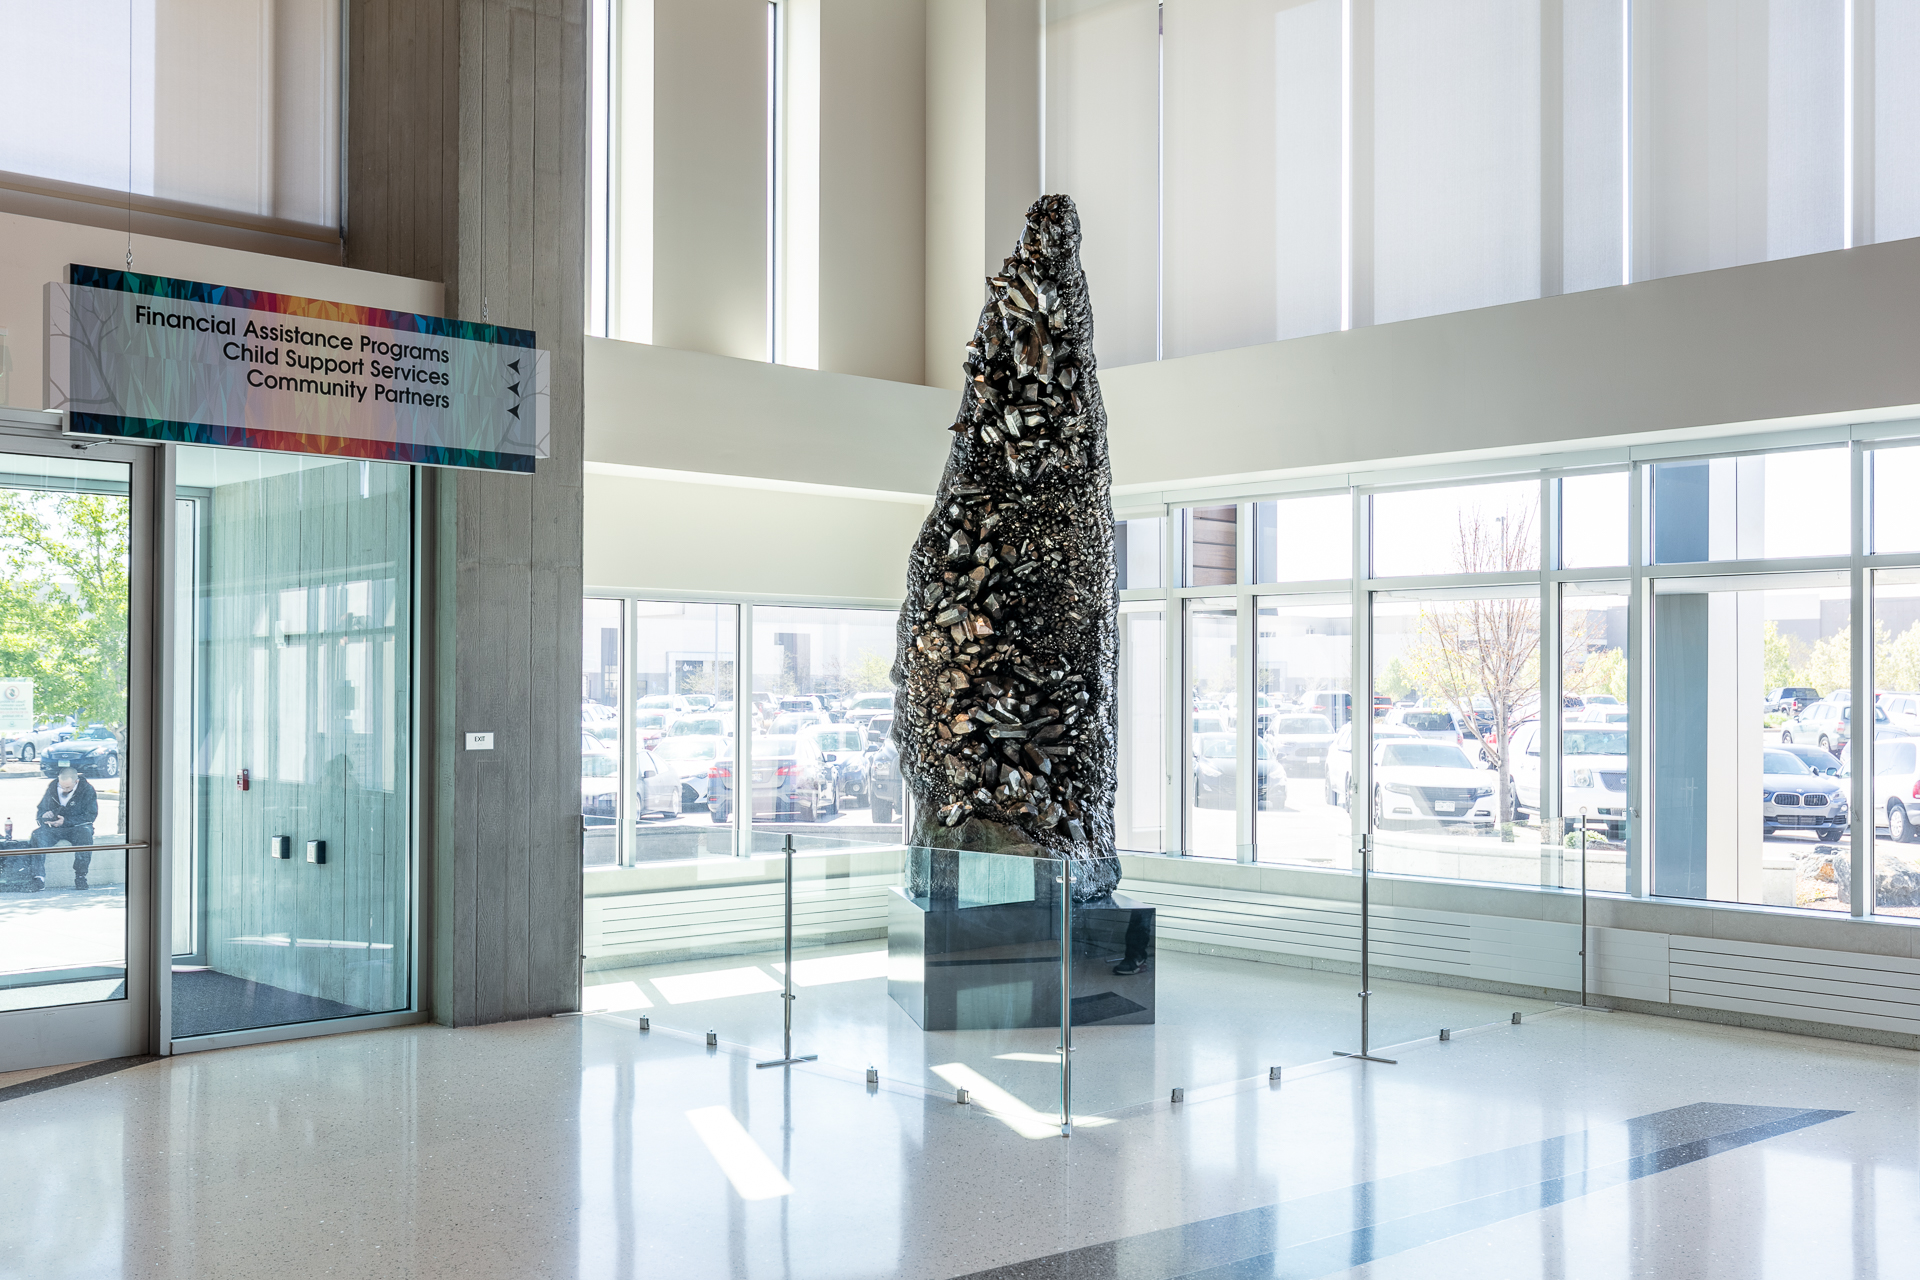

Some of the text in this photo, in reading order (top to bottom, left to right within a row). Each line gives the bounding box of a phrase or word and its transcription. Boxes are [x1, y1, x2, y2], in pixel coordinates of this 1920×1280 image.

[135, 304, 450, 364] Financial Assistance Programs
[222, 341, 450, 386] Child Support Services
[246, 368, 450, 409] Community Partners
